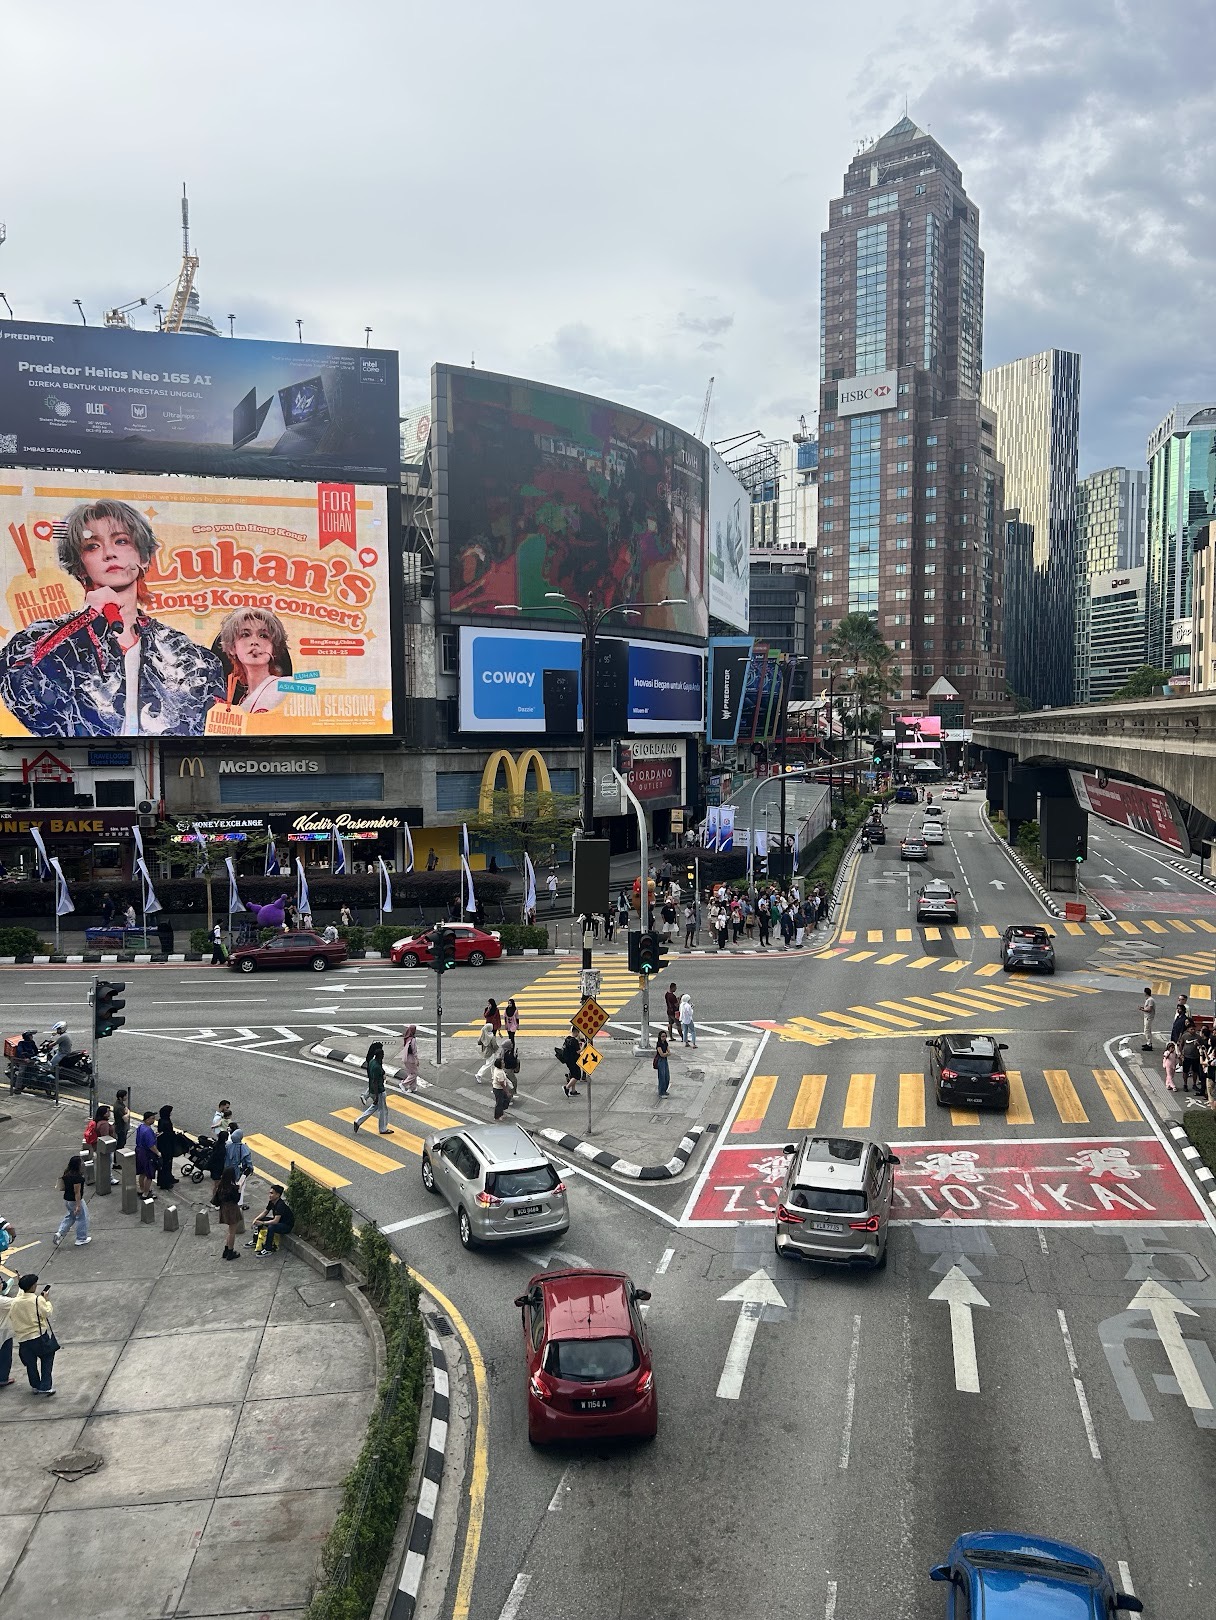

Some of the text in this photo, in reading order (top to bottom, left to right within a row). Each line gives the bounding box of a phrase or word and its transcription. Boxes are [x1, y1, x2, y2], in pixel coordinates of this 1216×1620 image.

[5, 333, 54, 342] PREDATOR
[18, 361, 212, 386] Predator Helios Neo 16S AI
[28, 380, 203, 399] DIREKA BENTUK UNTUK PRESTASI UNGGUL
[840, 388, 873, 404] HSBC
[86, 402, 104, 415] OLED
[46, 447, 81, 455] SEKARANG
[321, 490, 351, 512] FOR
[322, 512, 352, 532] LUHAN
[192, 523, 307, 541] See you in Hong Kong!
[144, 540, 372, 605] Luhan's
[14, 583, 67, 609] ALL FOR
[18, 599, 72, 628] LUHAN
[146, 589, 363, 629] Hong Kong concert
[294, 671, 319, 680] LUHAN
[482, 670, 536, 688] coway
[633, 677, 654, 688] Inovasi
[653, 679, 670, 691] Elegan
[723, 668, 731, 709] PREDATOR
[284, 694, 376, 716] LUHAN SEASON4
[210, 711, 243, 727] LUHAN
[207, 724, 242, 736] SEASON4
[89, 752, 131, 760] TRAVELOGUE
[632, 742, 678, 757] GIORDANO
[219, 759, 319, 773] McDonald's
[628, 768, 673, 783] GIORDANO
[638, 781, 664, 791] OUTLET
[50, 819, 105, 832] BAKE
[192, 820, 264, 829] MONEY EXCHANGE
[292, 811, 401, 832] Kadir Pasembor
[713, 1185, 782, 1213] ZO
[580, 1400, 607, 1409] W 1154 A
